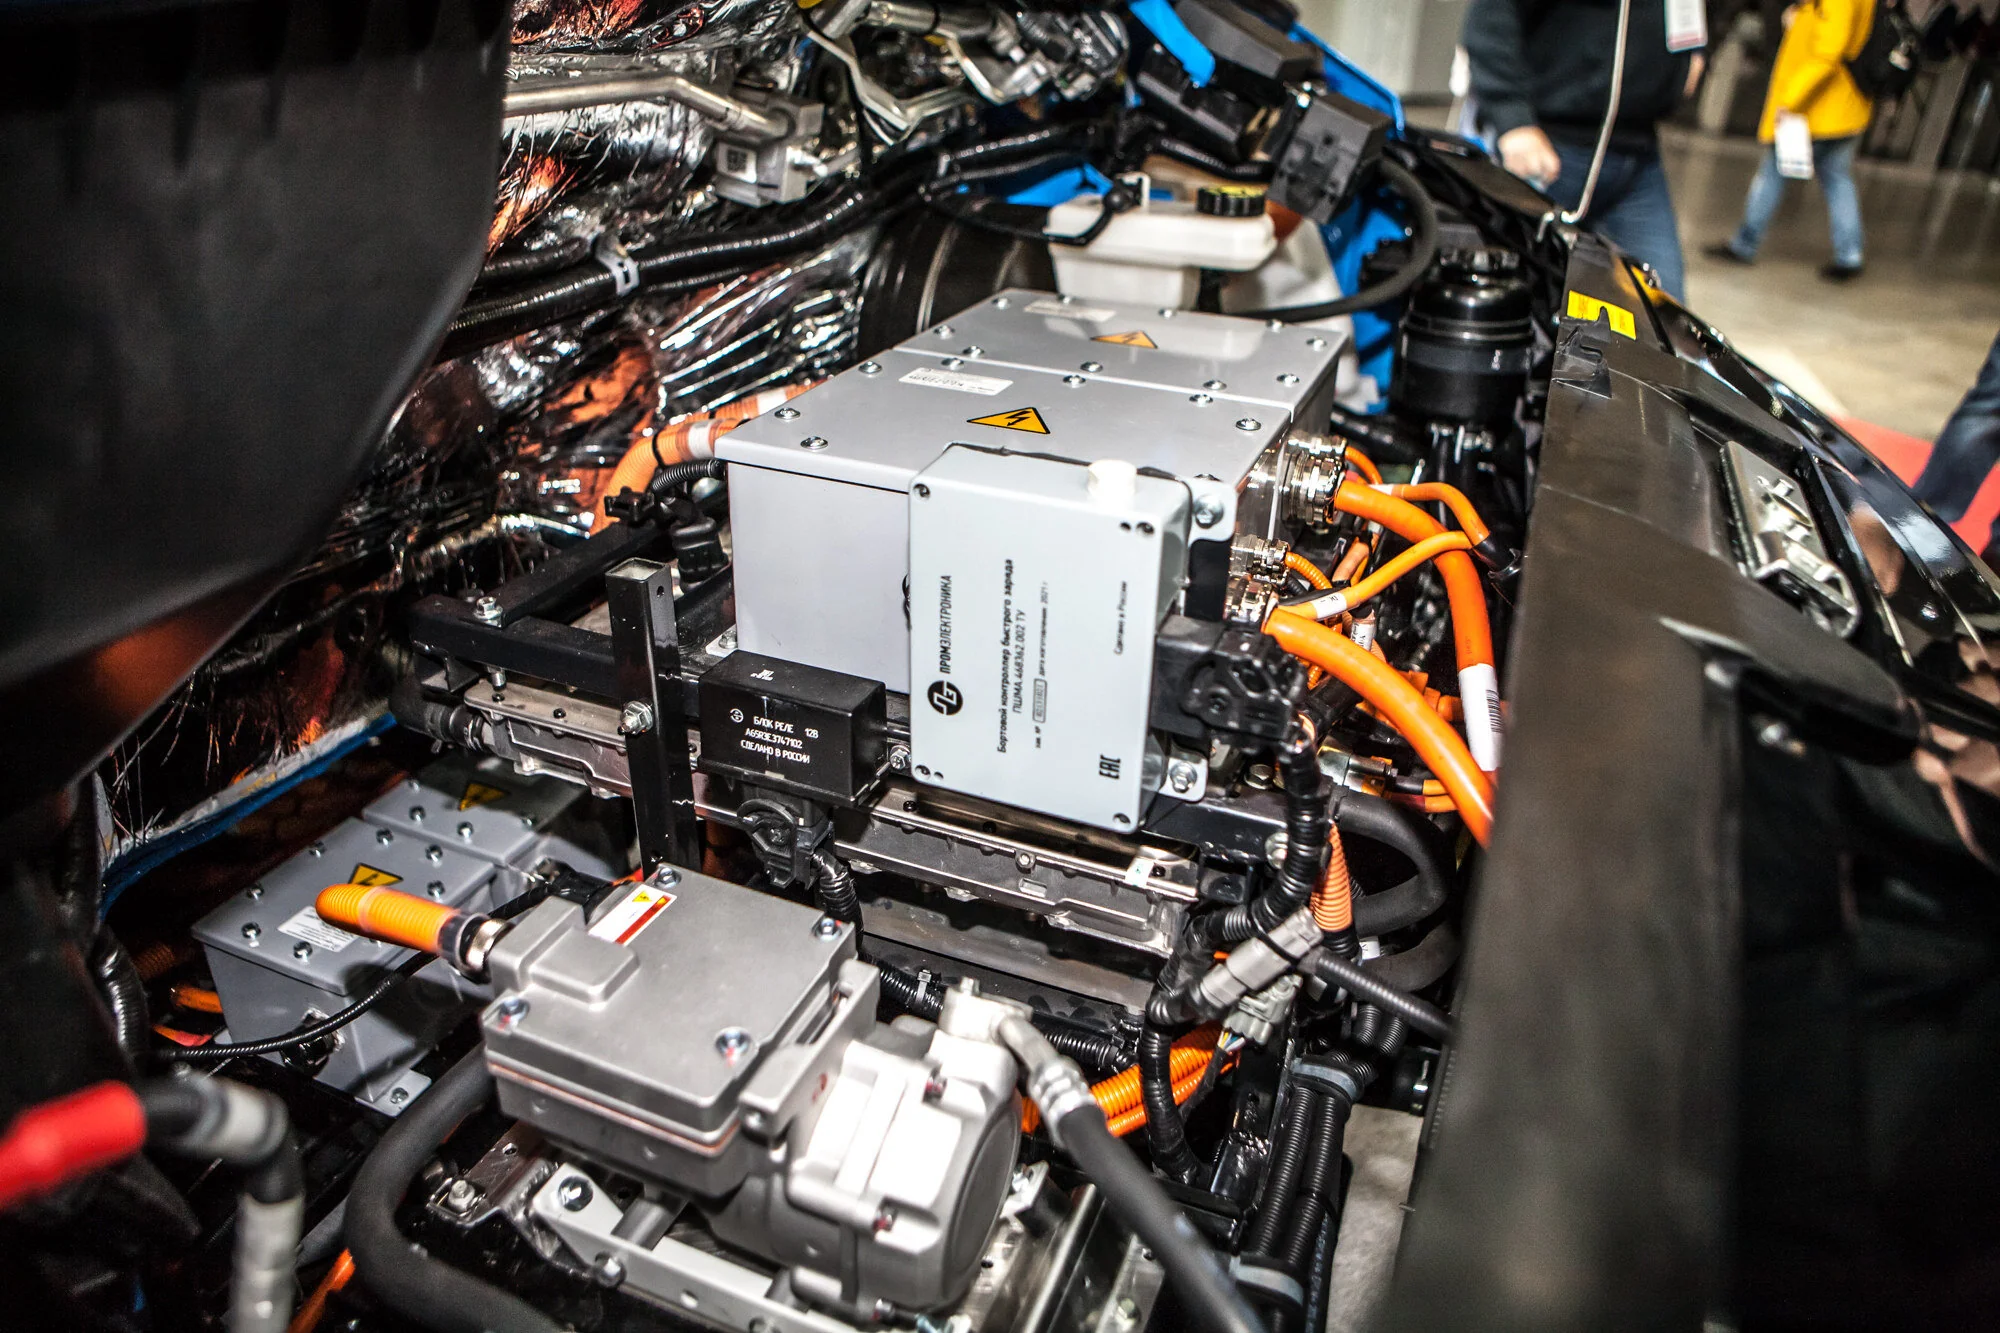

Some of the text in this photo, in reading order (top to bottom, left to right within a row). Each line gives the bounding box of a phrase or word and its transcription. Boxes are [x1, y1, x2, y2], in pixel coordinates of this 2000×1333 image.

[939, 575, 952, 674] ПРОМЭЛЕКТРОНИКА
[1016, 609, 1026, 622] ТУ
[997, 559, 1014, 753] Бортовой контроллер быстрого заряда
[753, 716, 774, 729] БЛОК
[775, 721, 794, 734] РЕЛЕ
[740, 739, 811, 764] СДЕЛАНО В РОССИИ
